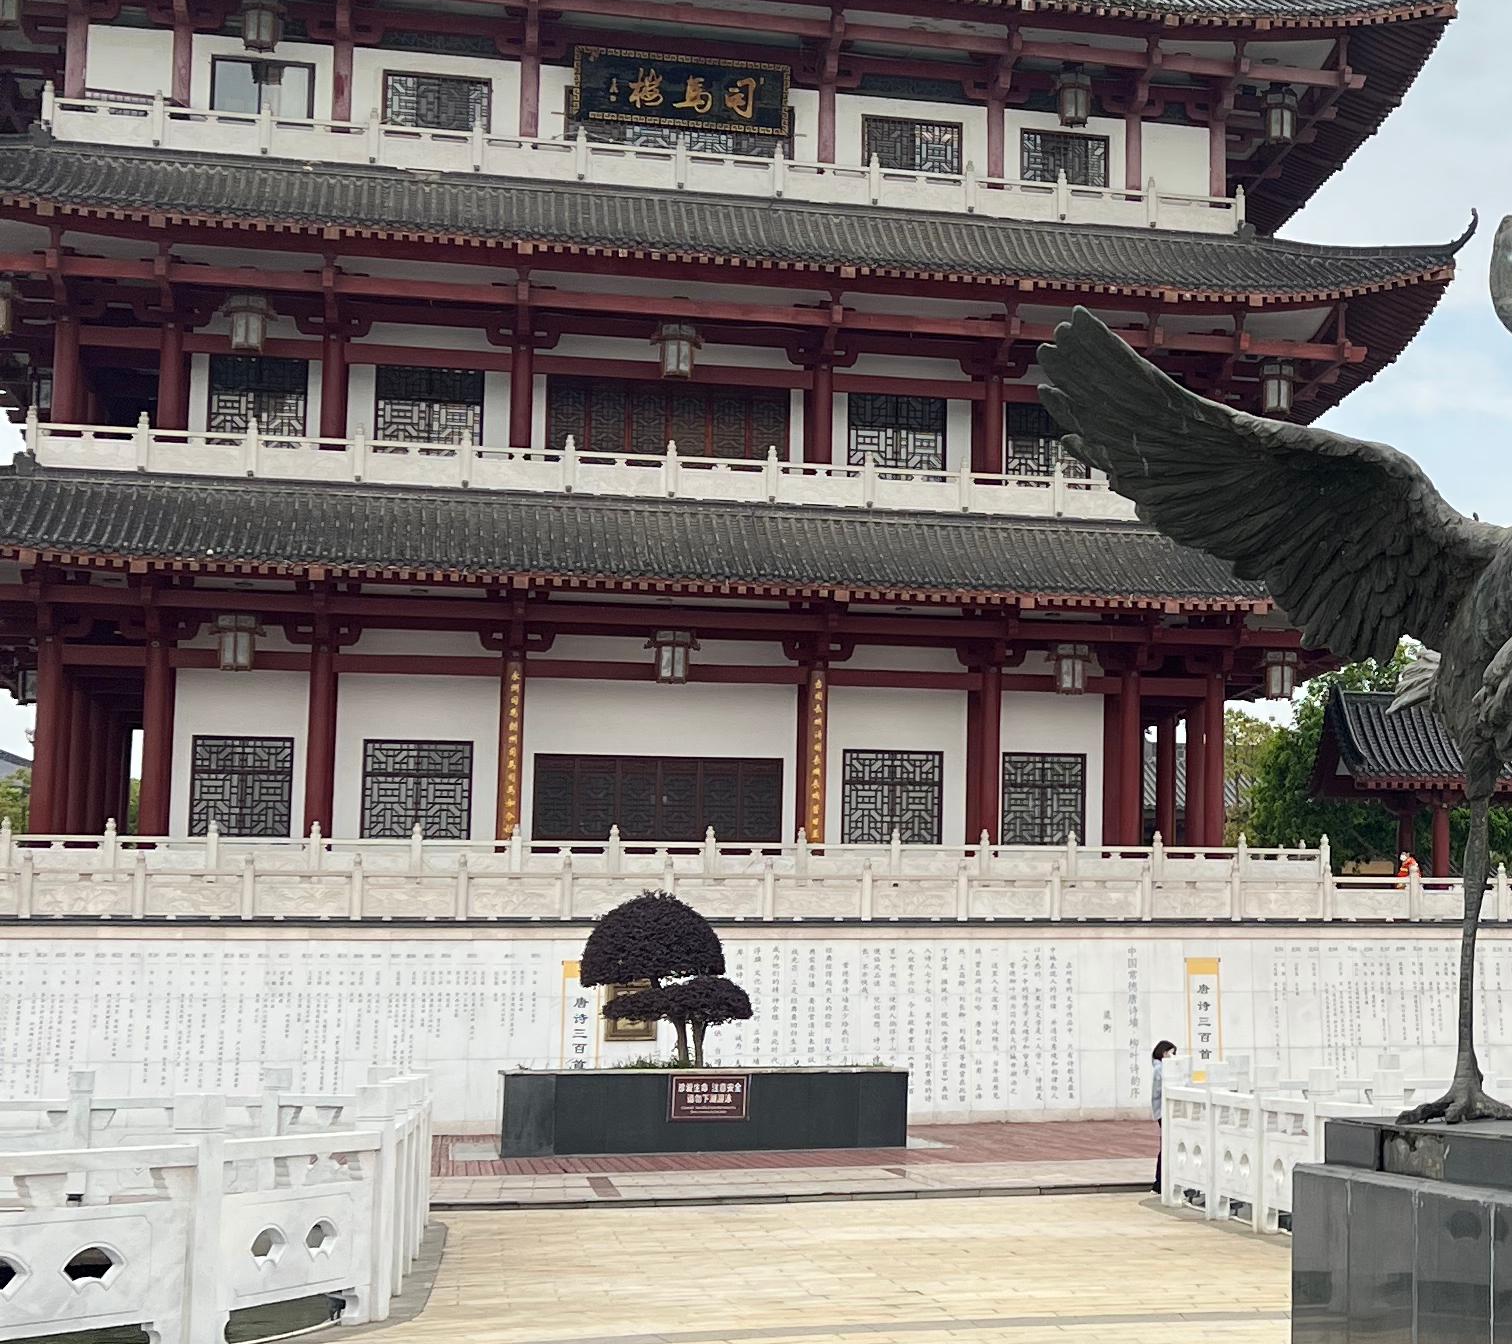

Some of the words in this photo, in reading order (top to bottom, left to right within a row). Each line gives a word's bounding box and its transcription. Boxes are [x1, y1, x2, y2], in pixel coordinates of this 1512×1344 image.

[1197, 984, 1212, 1059] 唐诗三百首
